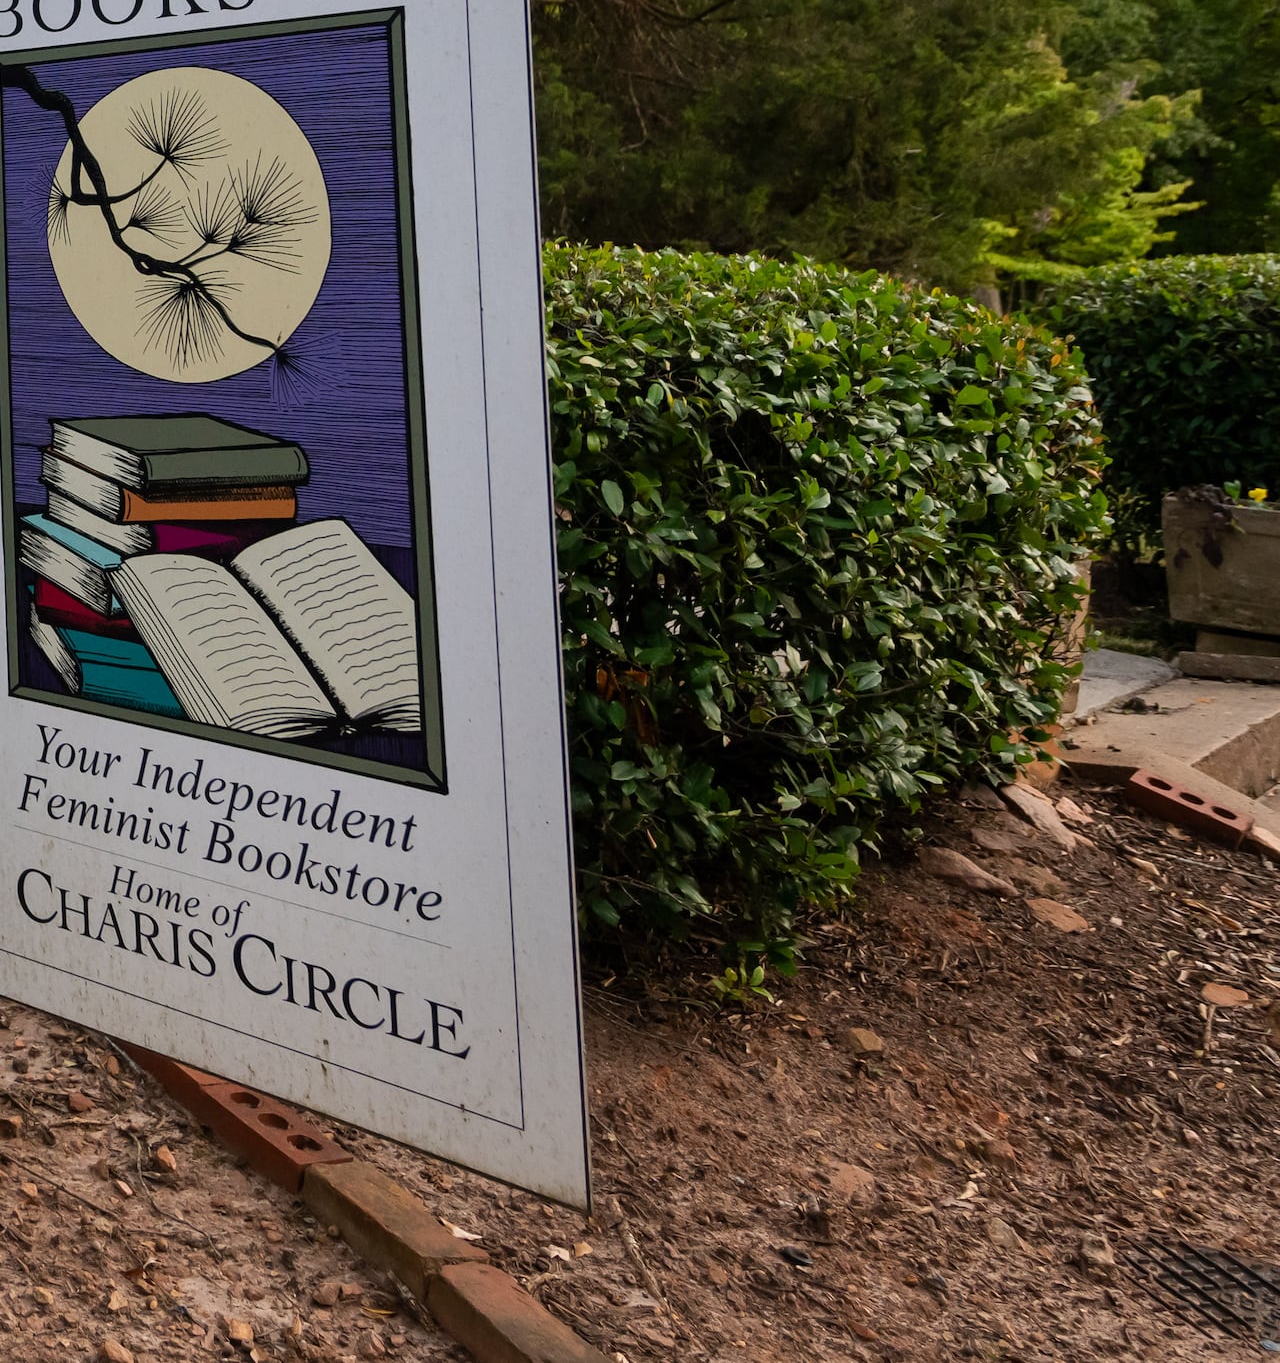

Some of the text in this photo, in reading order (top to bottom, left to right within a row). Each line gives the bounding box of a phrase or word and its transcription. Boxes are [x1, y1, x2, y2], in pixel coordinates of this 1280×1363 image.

[17, 773, 443, 922] Feminist Bookstore
[36, 724, 418, 852] Your Independent
[17, 868, 472, 1060] CHARIS CIRCLE
[108, 865, 250, 938] Home of
